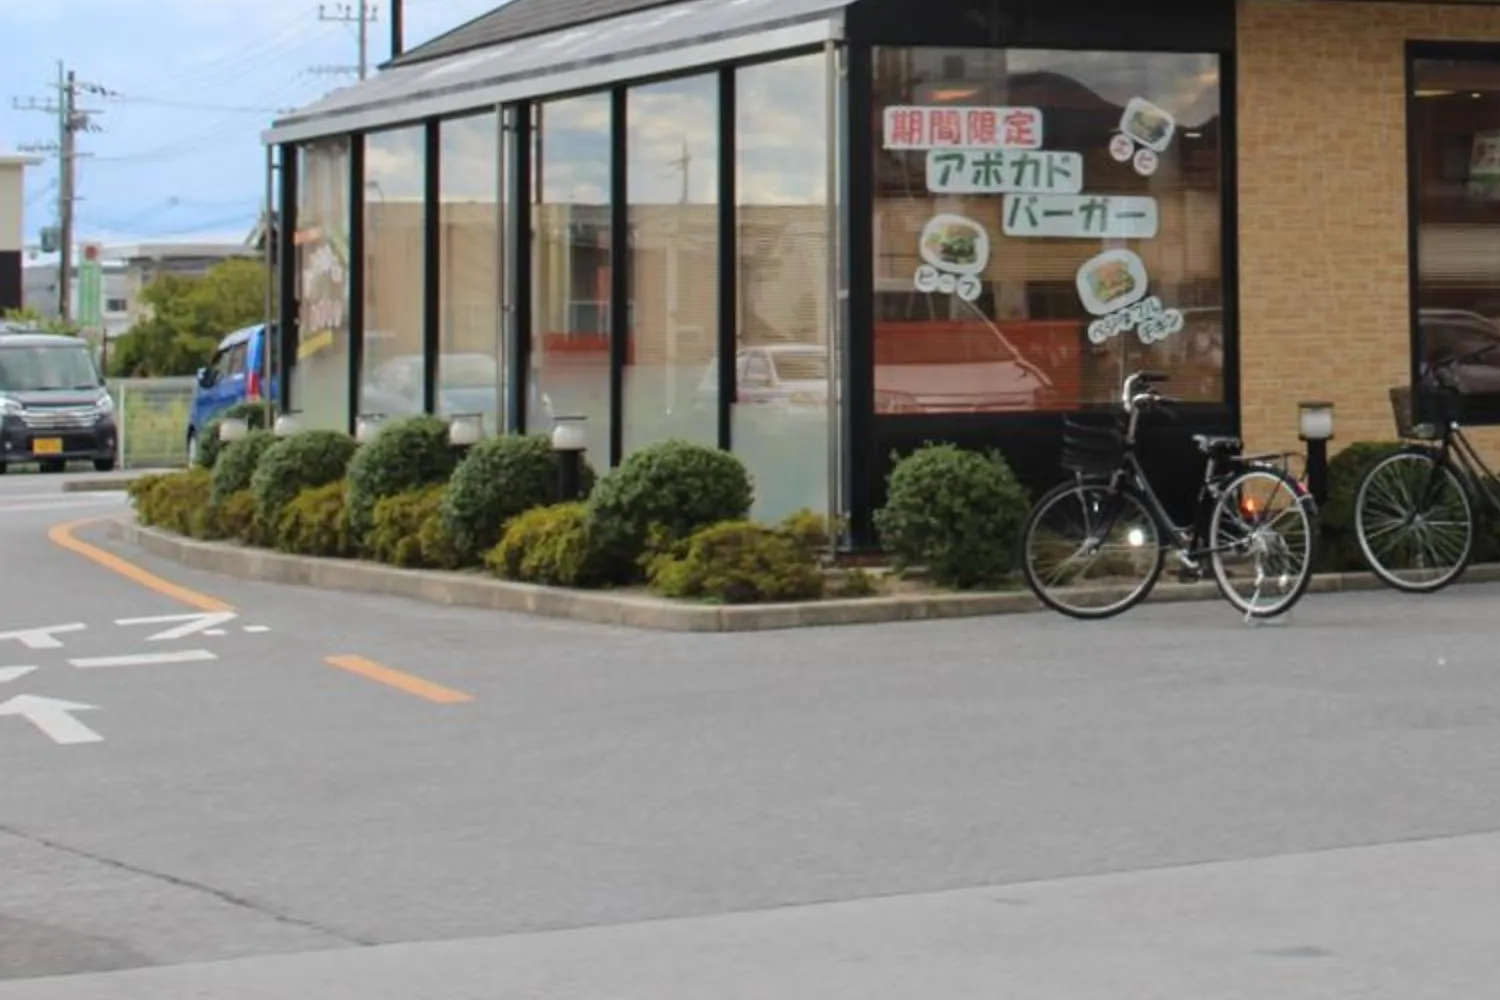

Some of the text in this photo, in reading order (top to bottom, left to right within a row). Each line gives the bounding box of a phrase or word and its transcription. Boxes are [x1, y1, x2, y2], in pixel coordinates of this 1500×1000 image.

[889, 108, 1037, 146] 期間限定
[933, 150, 1073, 189] アボカド
[1007, 196, 1147, 232] バーガー
